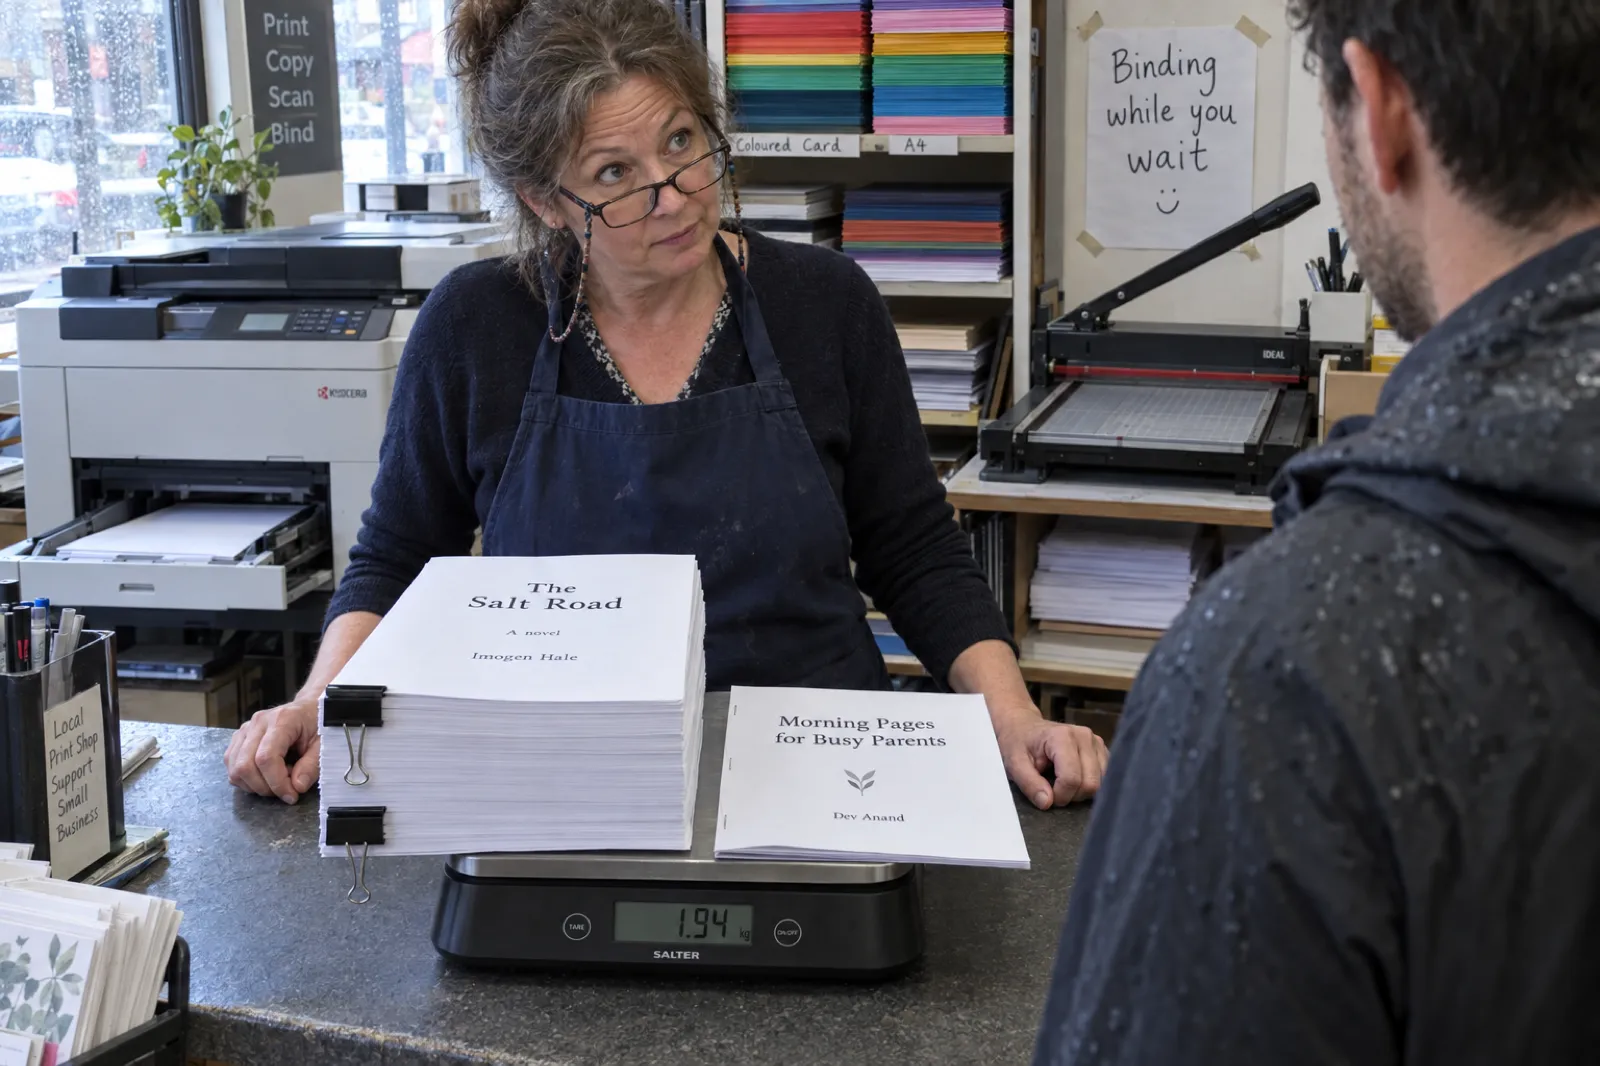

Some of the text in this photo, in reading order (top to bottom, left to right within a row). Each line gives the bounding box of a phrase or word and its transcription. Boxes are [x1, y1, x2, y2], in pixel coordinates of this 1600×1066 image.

[263, 12, 310, 36] Print
[266, 49, 314, 77] Copy
[1111, 43, 1217, 97] Binding
[268, 85, 315, 108] Scan
[1107, 93, 1237, 137] while you
[271, 120, 315, 145] Bind
[735, 137, 928, 153] Coloured Card A4
[1127, 138, 1209, 174] wait
[1263, 350, 1285, 359] IDEAL
[527, 582, 577, 594] The
[467, 596, 623, 610] Salt Road
[471, 652, 578, 663] Imogen Hale
[53, 706, 84, 740] Local
[778, 715, 935, 733] Morning Pages
[49, 732, 98, 770] Print Shop
[775, 732, 947, 750] for Busy Parents
[51, 757, 94, 796] Support
[57, 783, 89, 818] Small
[56, 806, 99, 843] Business
[833, 812, 905, 822] Dev Anand
[569, 923, 585, 931] TARE
[679, 907, 750, 942] 1.94 kg
[653, 950, 700, 960] SALTER
